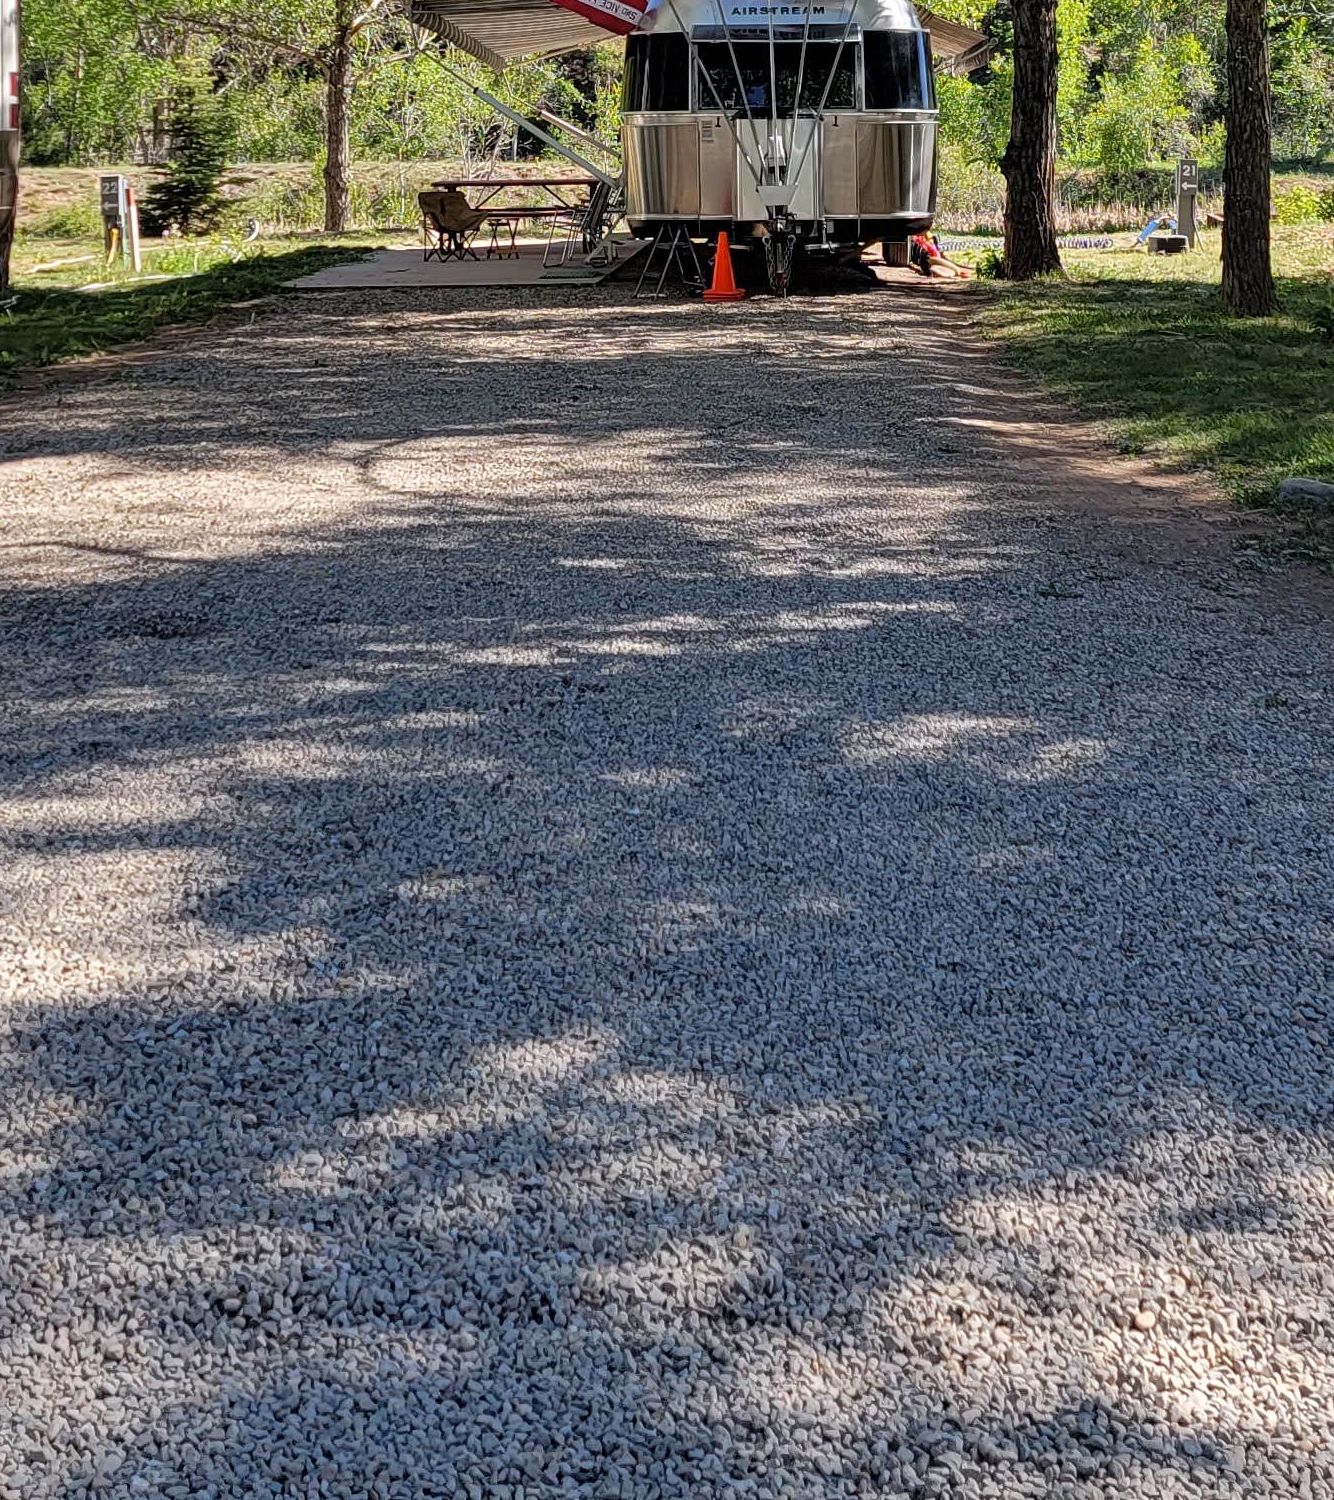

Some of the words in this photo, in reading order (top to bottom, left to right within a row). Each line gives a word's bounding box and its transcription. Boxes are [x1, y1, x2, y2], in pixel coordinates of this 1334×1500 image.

[730, 6, 825, 16] AIRSTREAM
[1182, 165, 1196, 176] 21
[102, 182, 117, 194] 22
